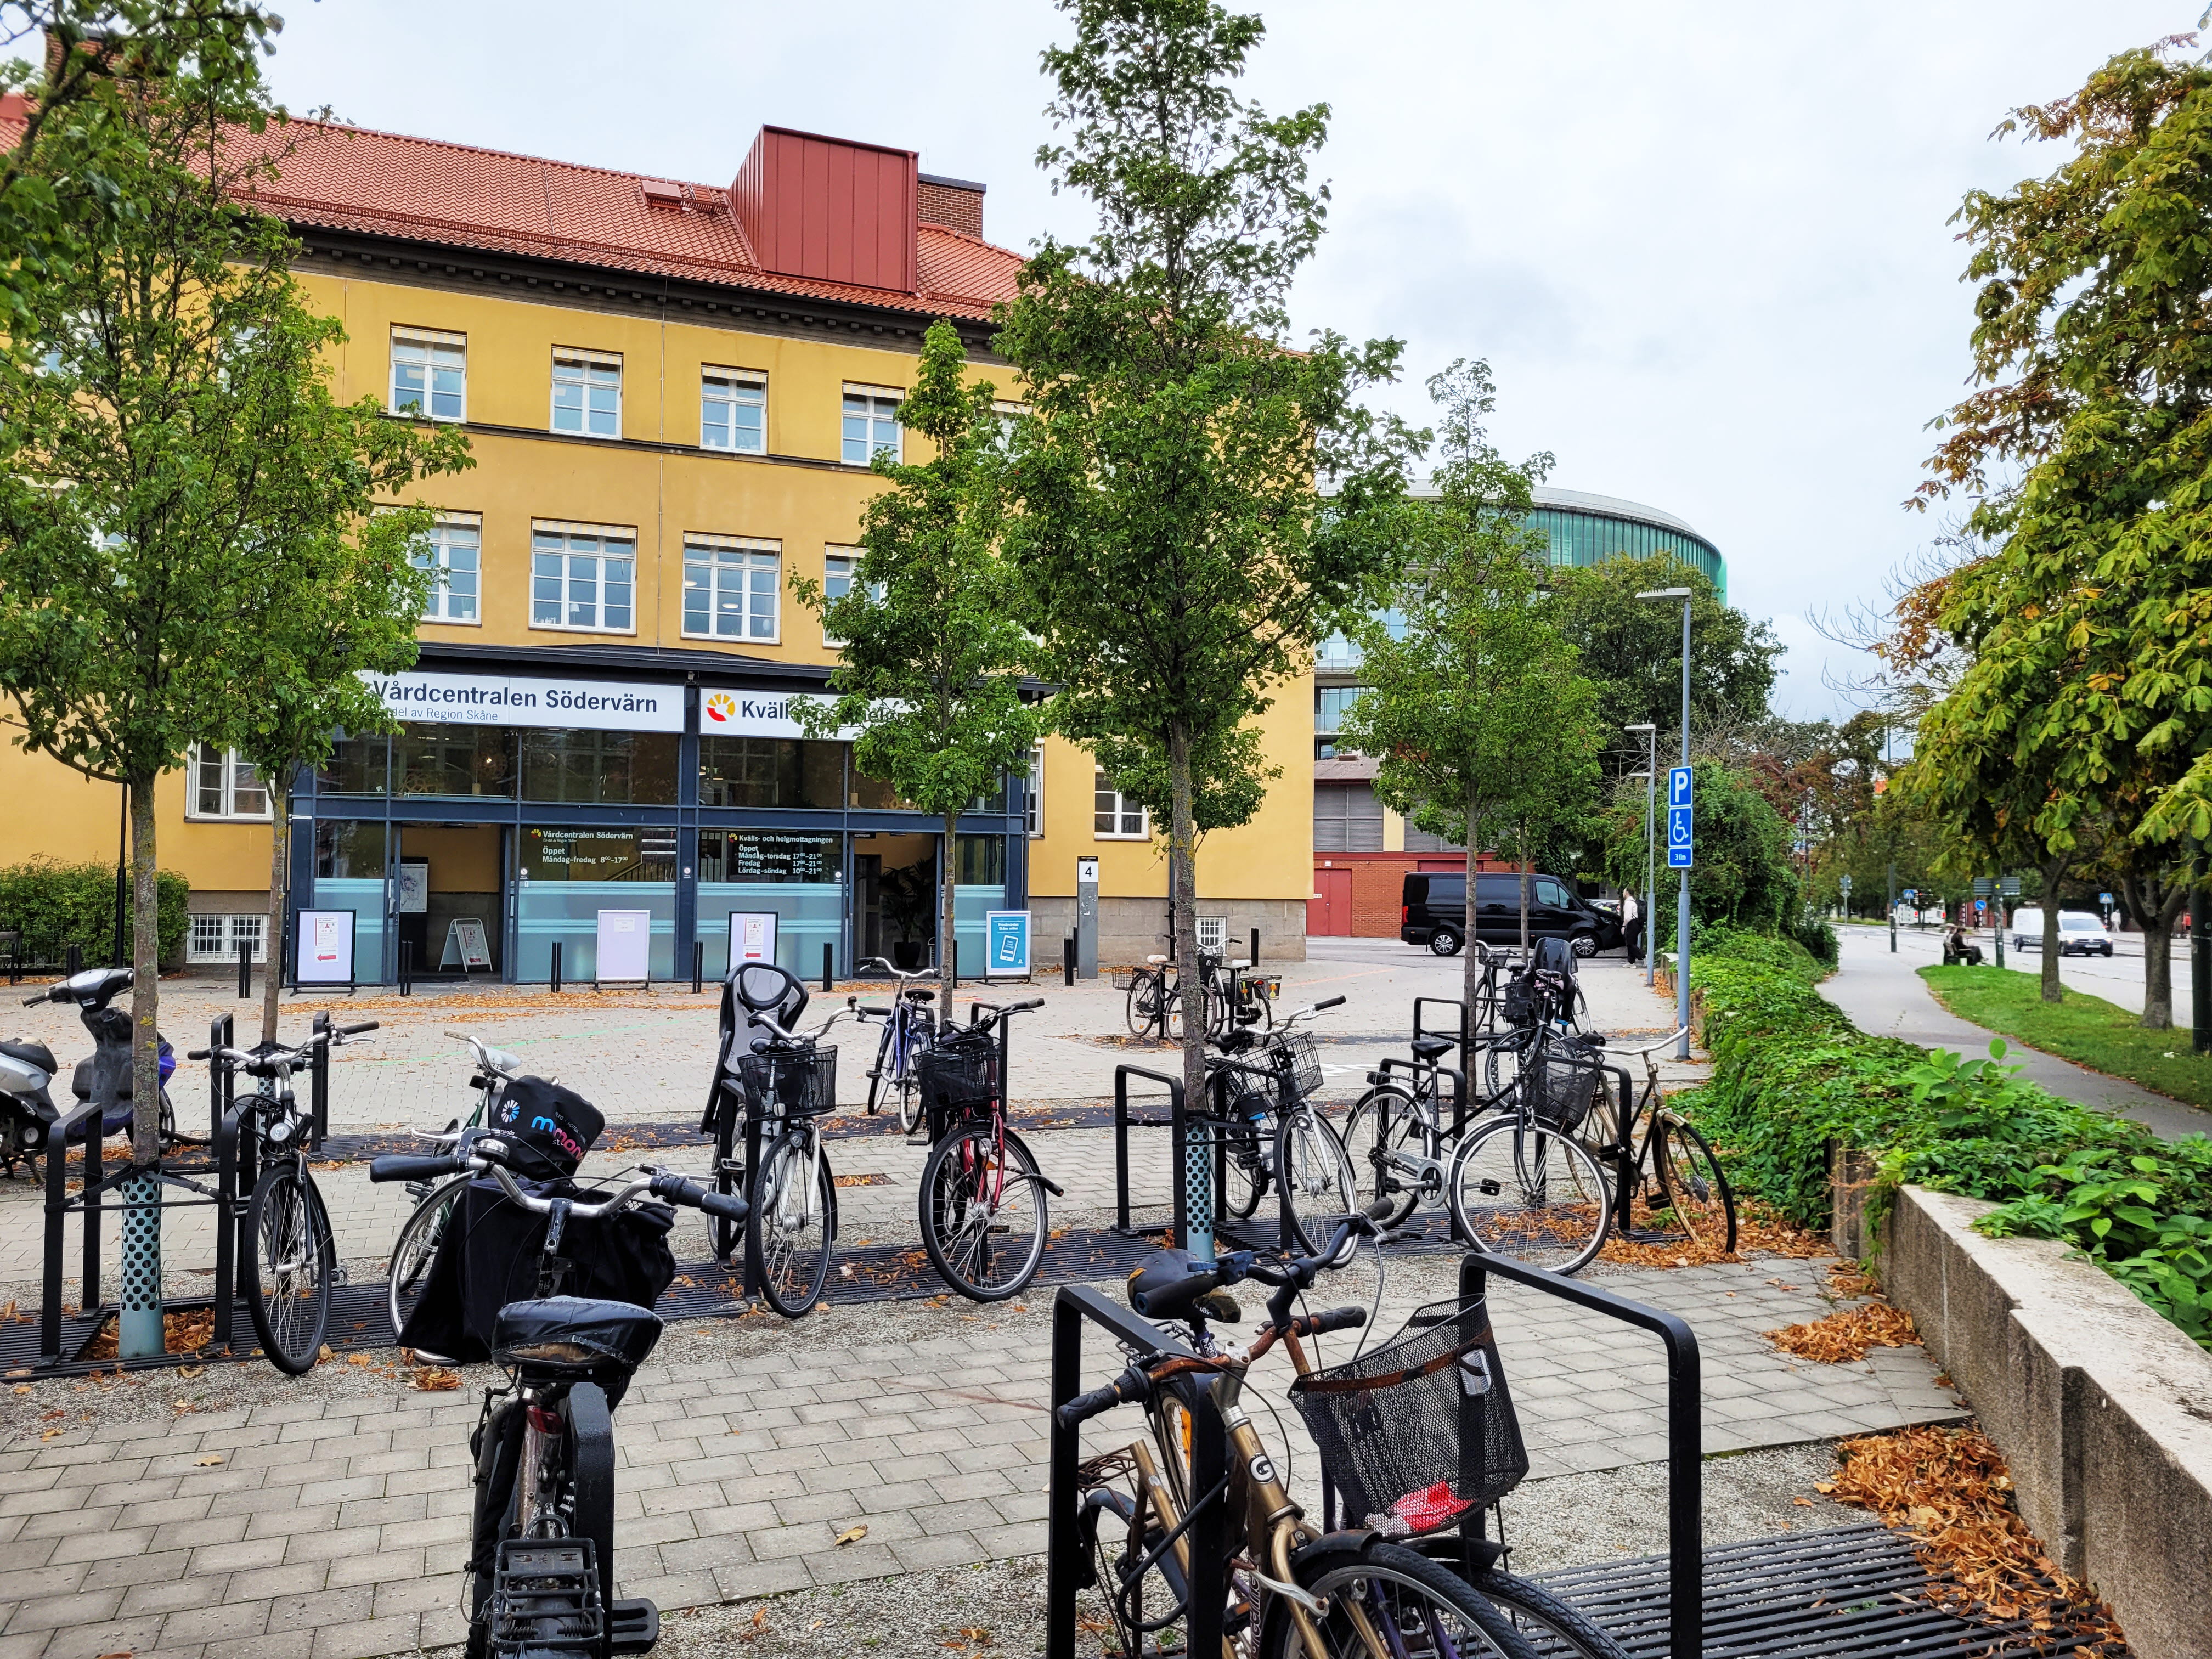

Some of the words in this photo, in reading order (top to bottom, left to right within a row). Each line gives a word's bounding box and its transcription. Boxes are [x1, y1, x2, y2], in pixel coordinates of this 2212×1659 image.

[373, 680, 536, 707] Vårdcentralen
[545, 689, 657, 713] Södervärn
[411, 709, 423, 718] av
[427, 708, 462, 721] Region
[466, 709, 498, 721] Skåne
[742, 701, 790, 719] Kväll
[1675, 771, 1689, 803] P
[543, 830, 594, 839] Vårdcentralen
[596, 831, 633, 839] Södervärn
[776, 836, 833, 844] helgmottagningen
[543, 845, 566, 855] Öppet
[738, 843, 758, 853] Öppet
[1085, 866, 1092, 877] 4
[1250, 1455, 1274, 1481] G
